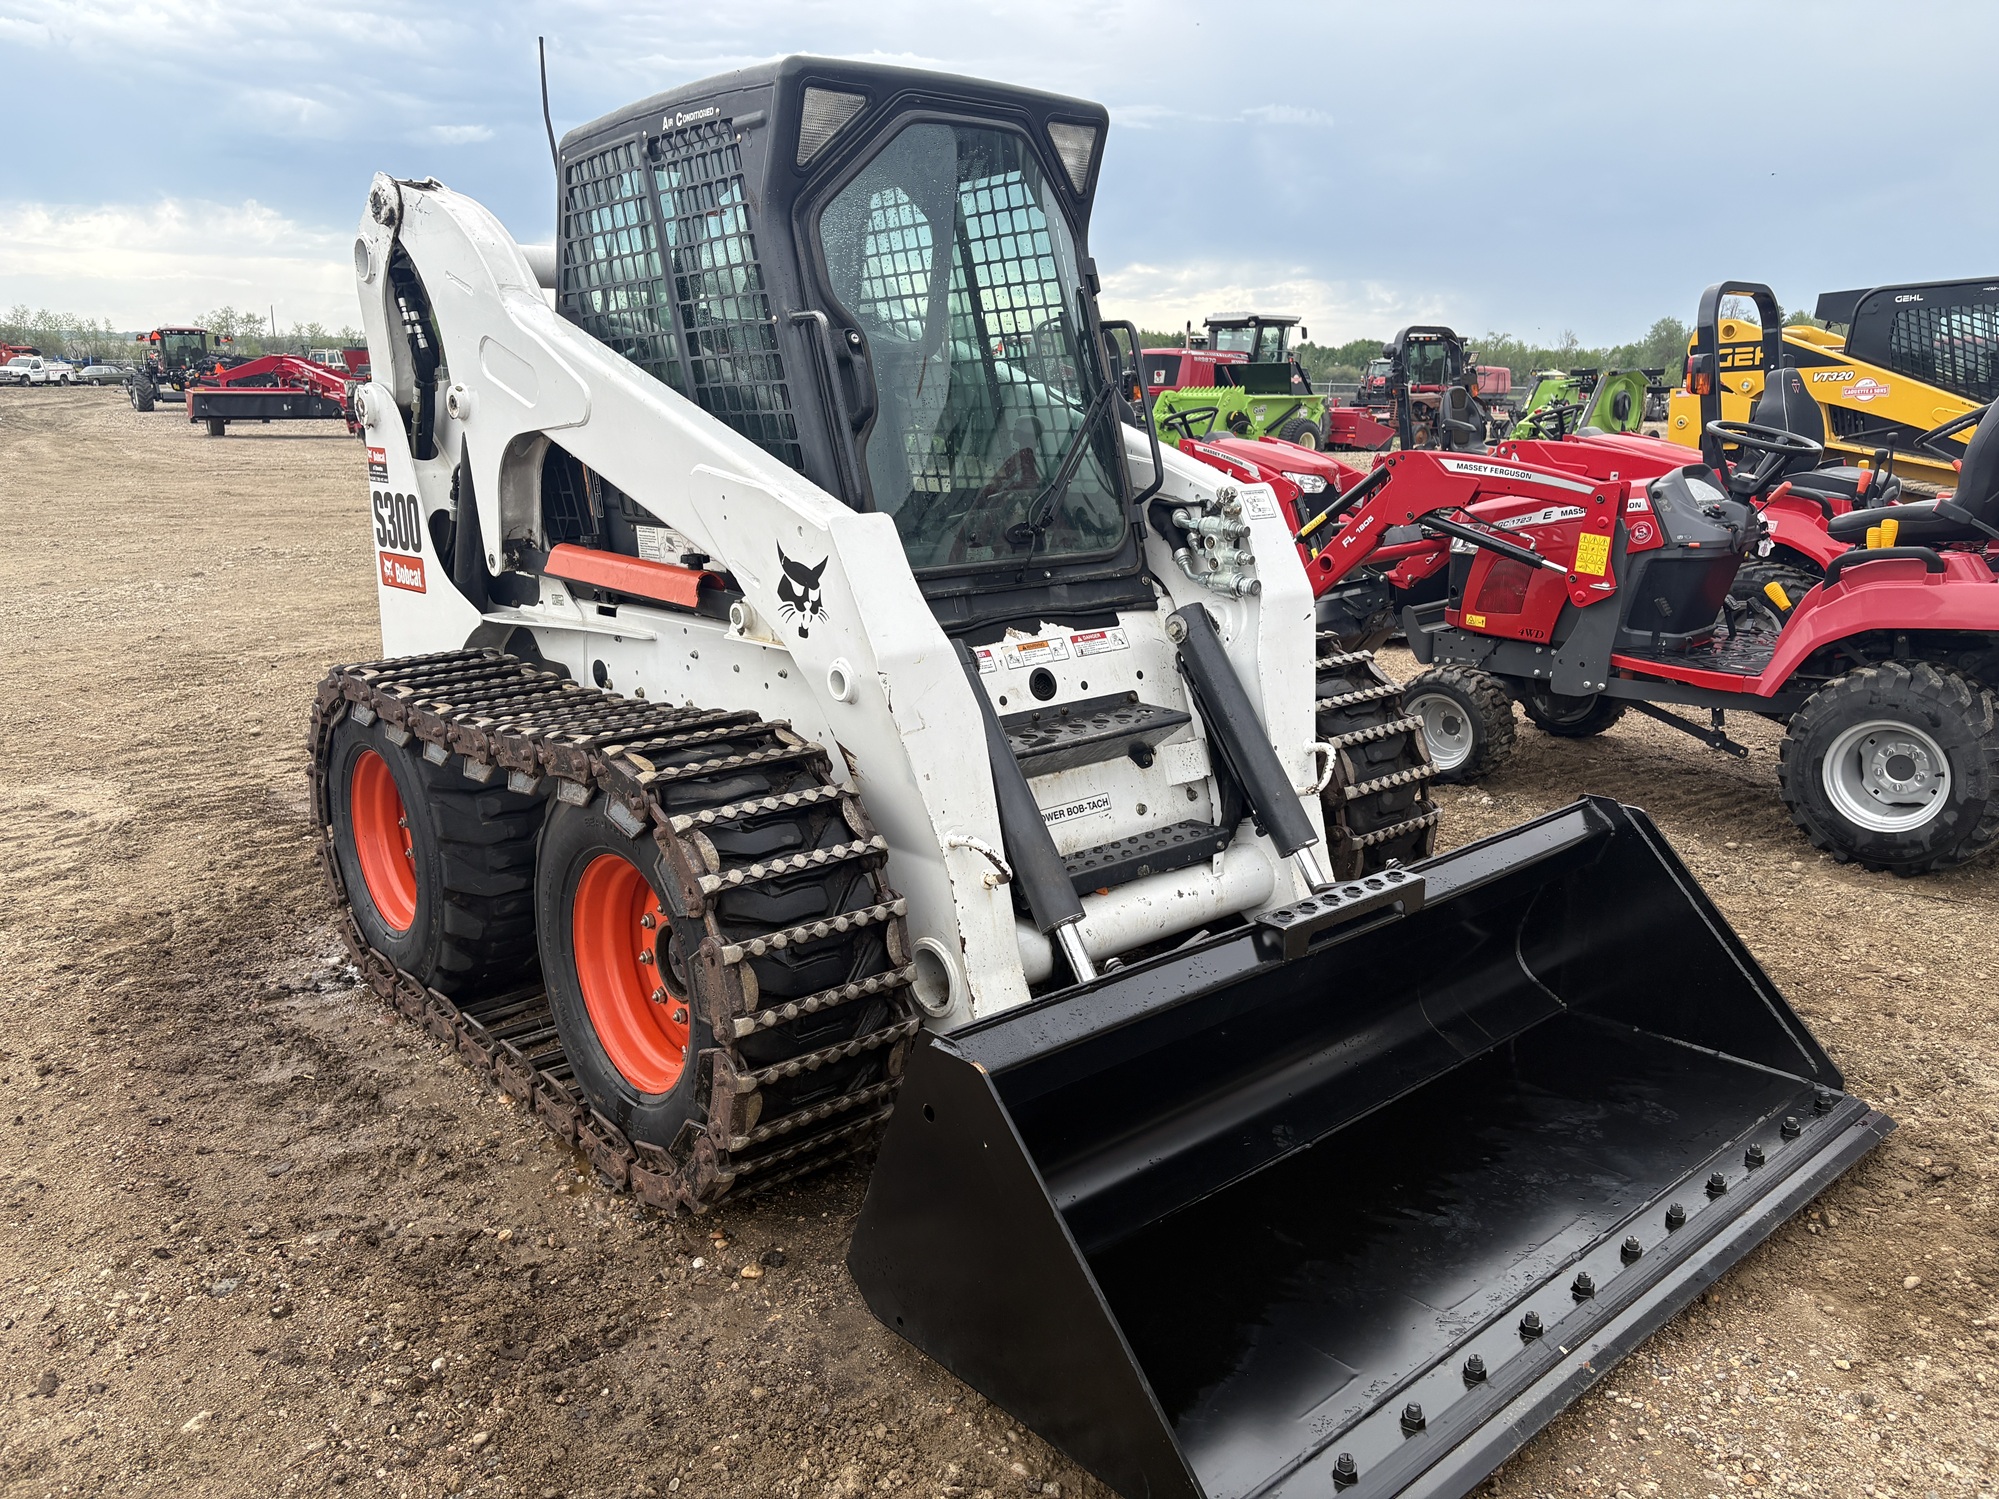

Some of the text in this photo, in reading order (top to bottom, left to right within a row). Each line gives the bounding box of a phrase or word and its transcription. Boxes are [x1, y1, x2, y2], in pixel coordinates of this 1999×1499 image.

[1894, 294, 1924, 303] GEHL
[1719, 346, 1764, 368] GEH
[1812, 370, 1855, 383] VT320
[1456, 462, 1533, 480] MASSEY FERGUSON
[372, 490, 422, 553] S300
[1511, 516, 1533, 525] 1723
[1543, 510, 1553, 520] E
[1341, 515, 1375, 548] FL 1805
[394, 562, 422, 588] Bobcat
[1082, 632, 1102, 641] DANGER
[1518, 628, 1545, 639] 4WD
[1026, 642, 1045, 651] WARNING
[1041, 797, 1109, 822] OWER BOB-TACH
